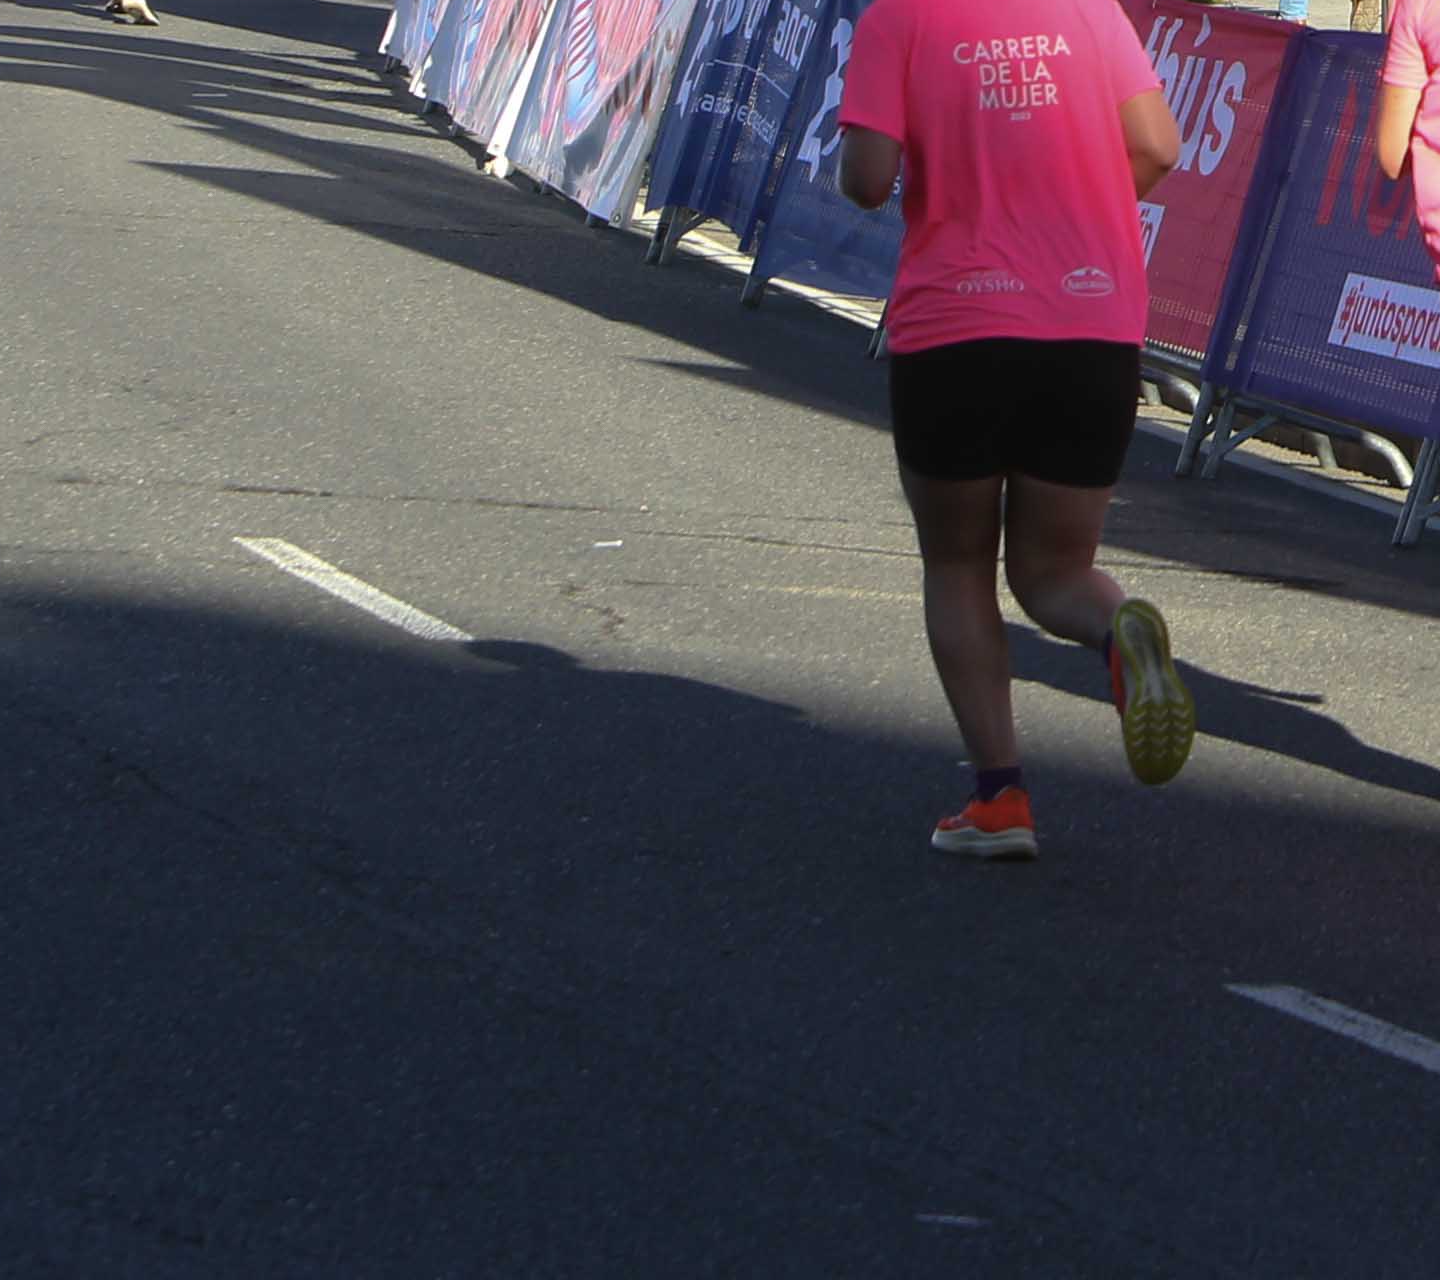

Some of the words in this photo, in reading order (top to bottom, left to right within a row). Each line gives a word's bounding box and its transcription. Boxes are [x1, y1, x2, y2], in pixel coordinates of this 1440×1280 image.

[952, 34, 1071, 65] CARRERA
[978, 63, 1012, 86] DE
[1021, 59, 1052, 82] LA
[978, 83, 1059, 111] MUJER
[956, 278, 1025, 295] OYSHO
